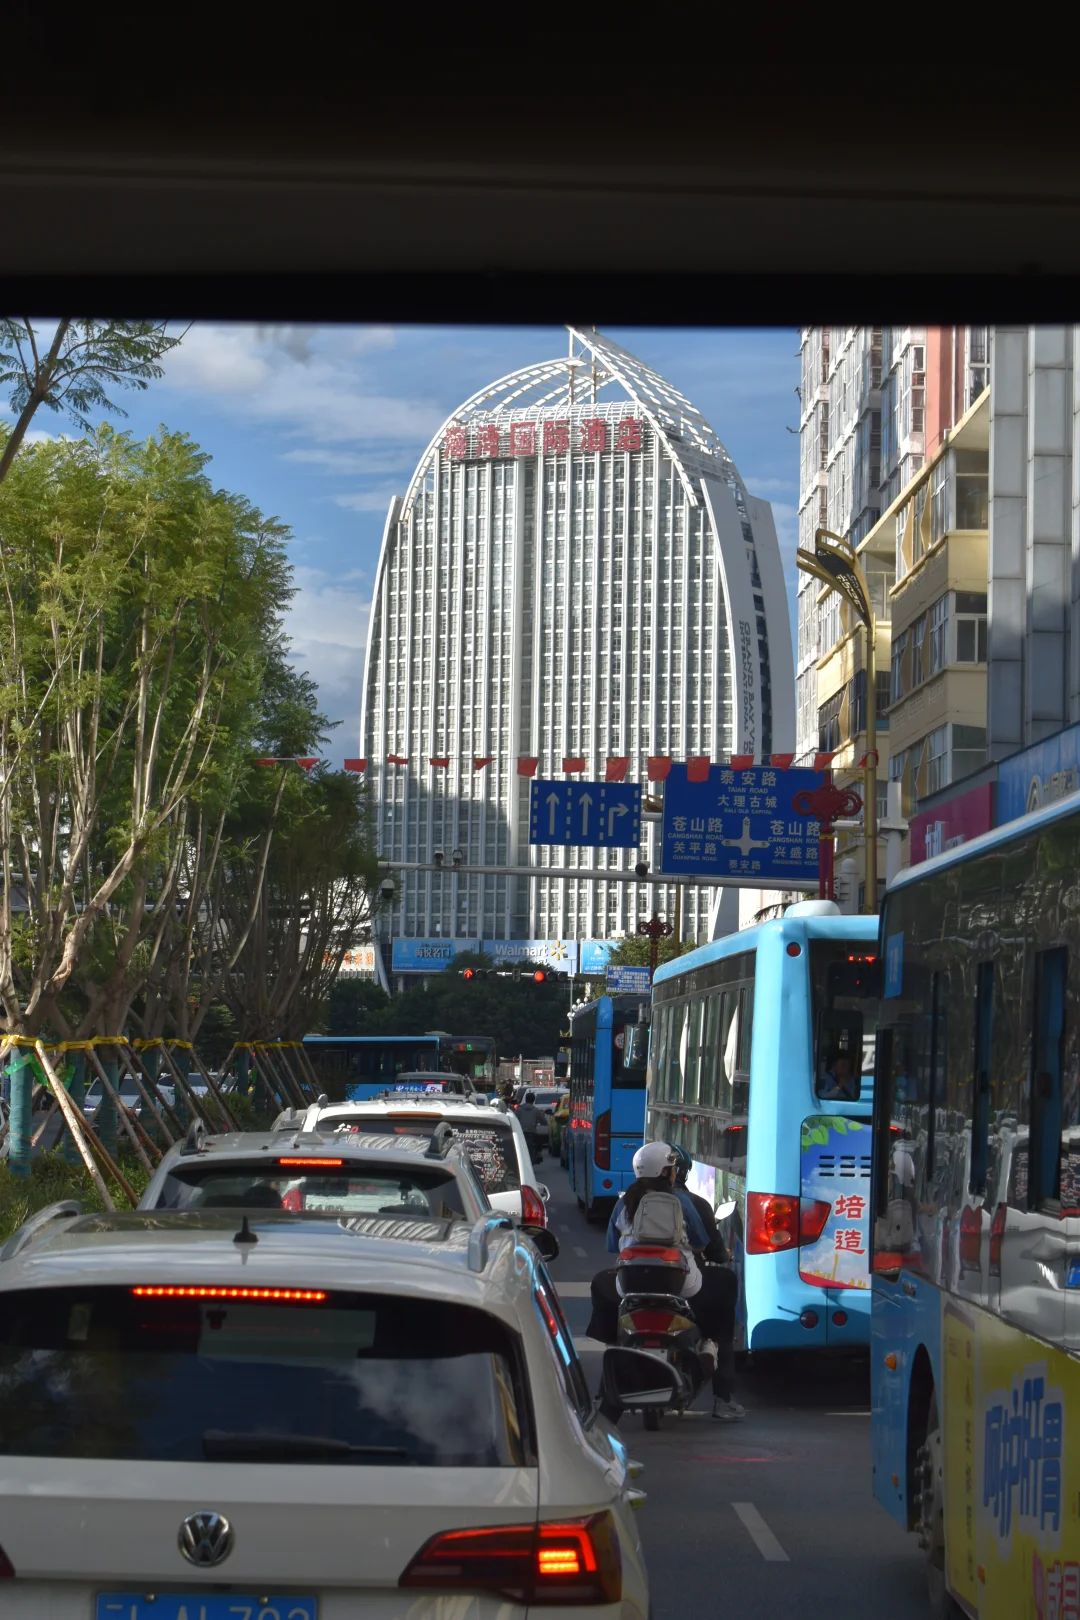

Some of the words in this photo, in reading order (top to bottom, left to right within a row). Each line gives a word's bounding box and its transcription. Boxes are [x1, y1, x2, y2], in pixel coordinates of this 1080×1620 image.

[444, 416, 643, 459] 海湾国际酒店
[744, 622, 754, 688] GRAND
[740, 620, 749, 731] INTERNATIONAL
[720, 770, 777, 787] 泰安路
[717, 794, 778, 808] 大理古城
[672, 816, 723, 833] 苍山路
[770, 820, 821, 837] 苍山路
[667, 832, 703, 840] CANGSHAN
[767, 836, 803, 844] CANGSHAN
[673, 841, 717, 855] 关平路
[774, 846, 818, 859] 兴盛路
[729, 860, 761, 870] 泰安路
[495, 944, 549, 956] Walmart
[834, 1194, 866, 1219] 培
[834, 1229, 866, 1255] 造
